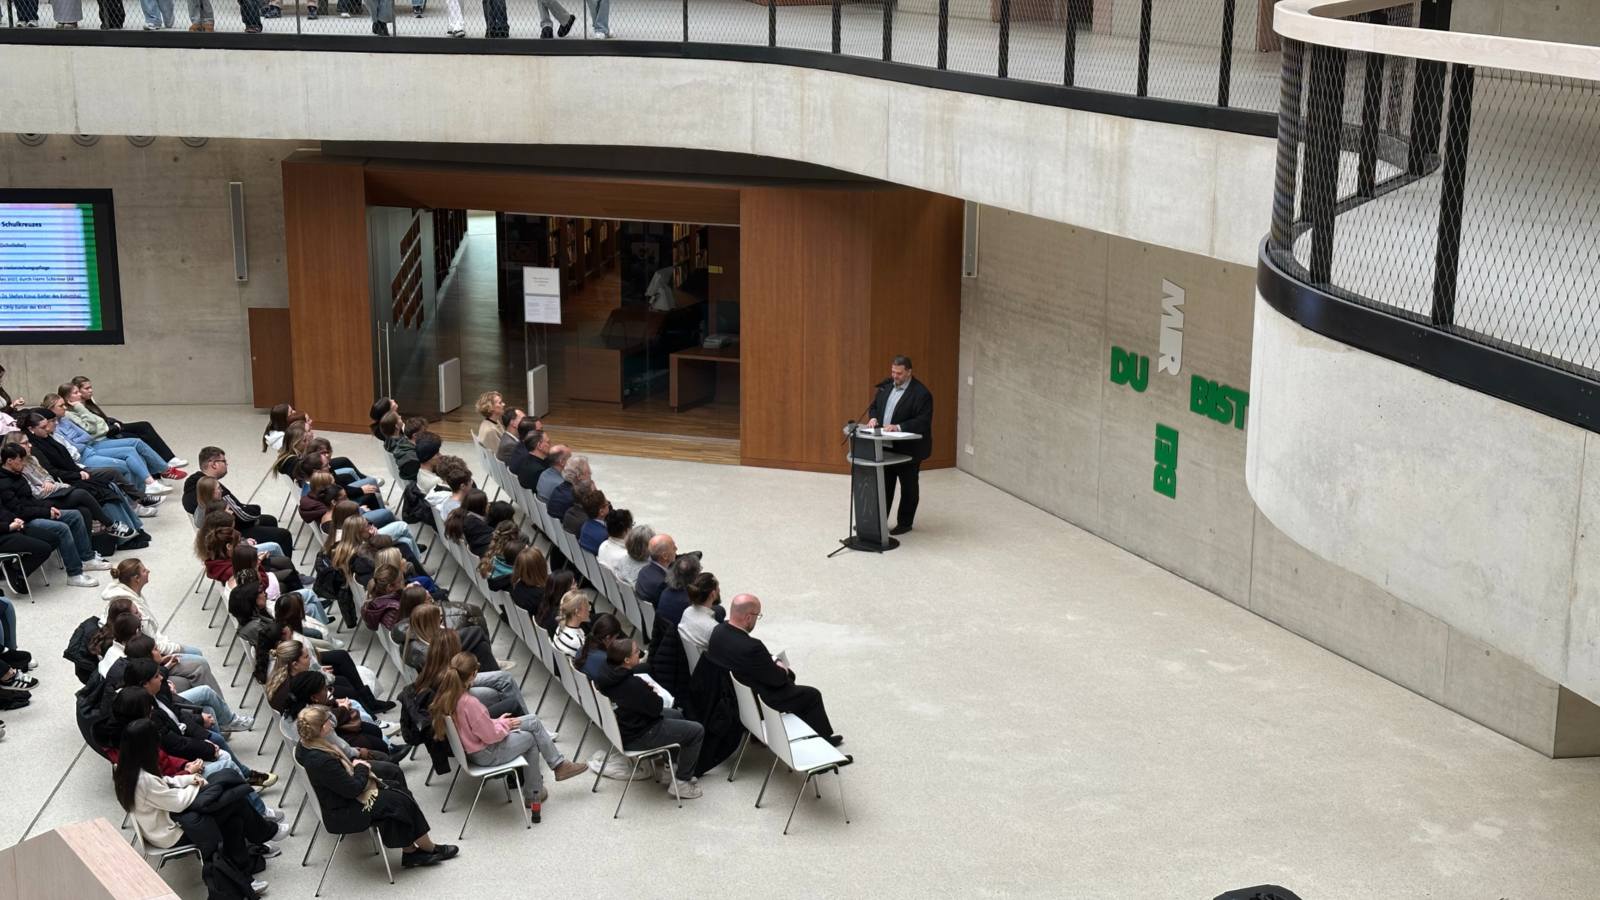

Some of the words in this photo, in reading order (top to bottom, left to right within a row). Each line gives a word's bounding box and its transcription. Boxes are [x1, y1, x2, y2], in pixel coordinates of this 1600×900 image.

[1158, 277, 1186, 376] MIR
[1110, 345, 1149, 393] DU
[1190, 373, 1250, 431] BIST
[1153, 422, 1179, 499] BEI
